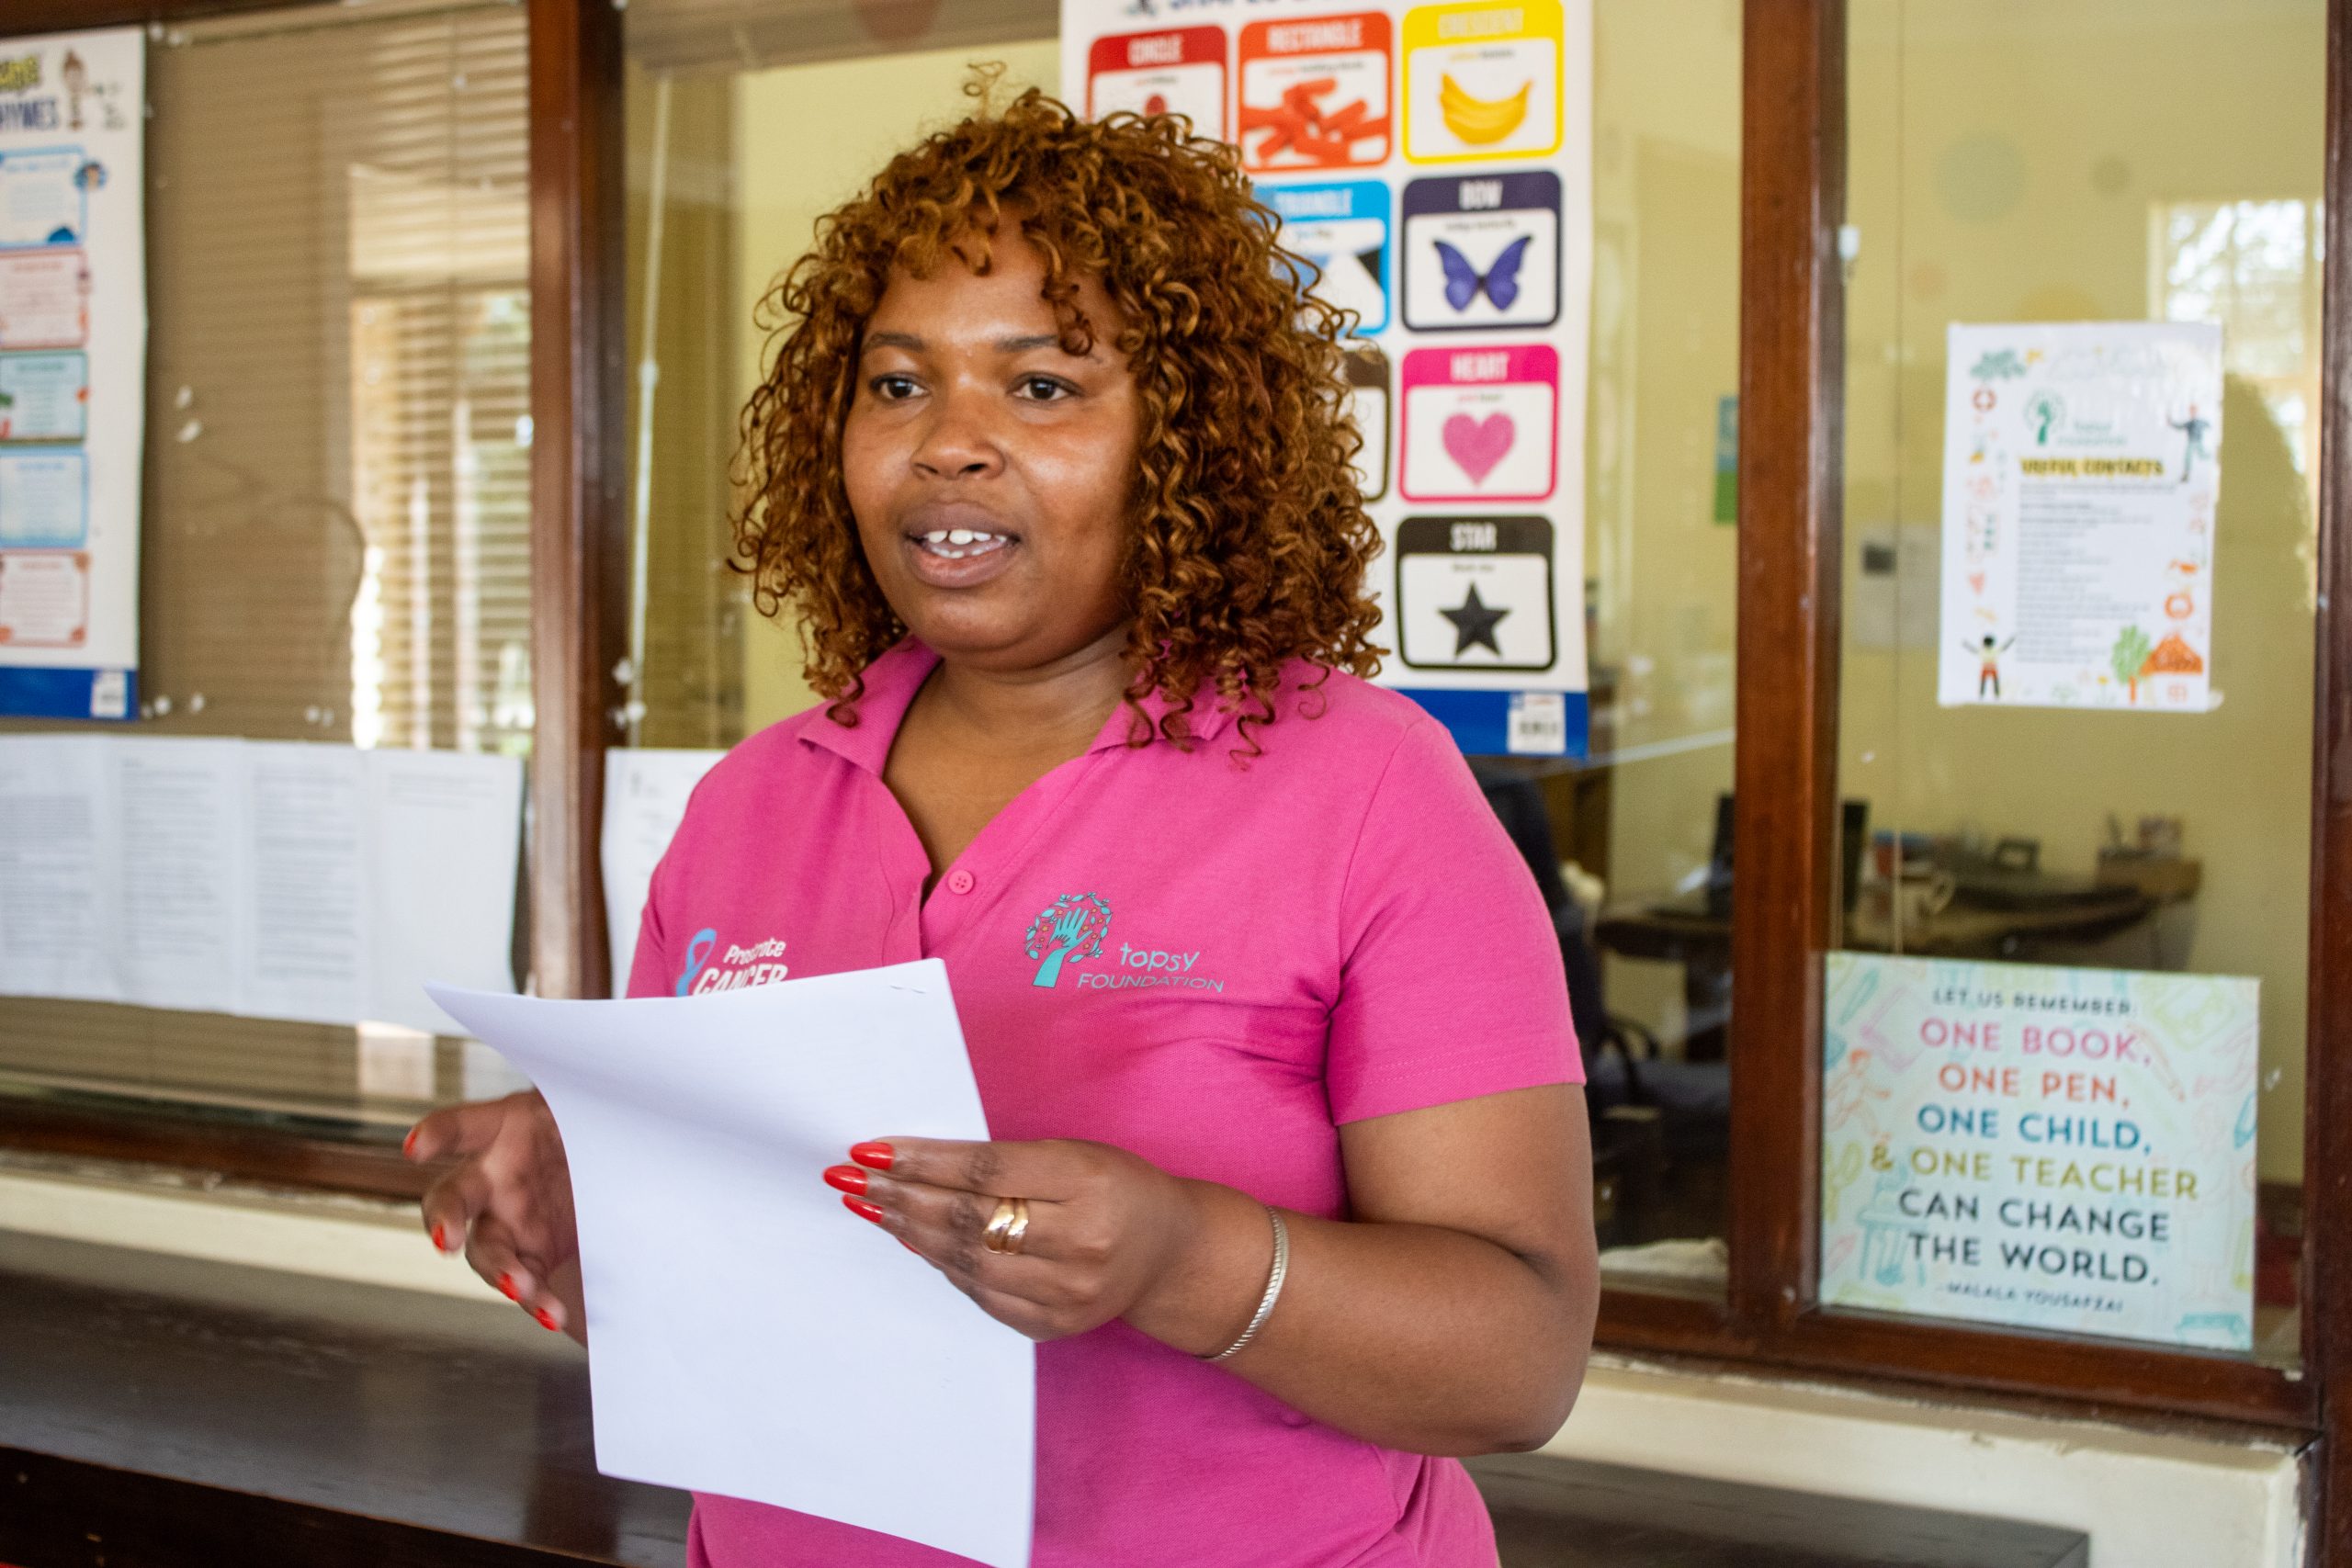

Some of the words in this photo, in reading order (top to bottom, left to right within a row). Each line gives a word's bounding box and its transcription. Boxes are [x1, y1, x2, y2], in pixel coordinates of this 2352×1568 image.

[1127, 33, 1183, 67] CIRCLE
[1267, 18, 1363, 52] RECTANGLE
[1458, 179, 1504, 210] BOW
[1450, 353, 1510, 381] HEART
[2021, 458, 2077, 476] USEFUL
[2084, 457, 2164, 476] CONTACTS
[1450, 522, 1497, 550] STAR
[1119, 942, 1201, 972] topsy
[1077, 973, 1225, 993] FOUNDATION
[1932, 987, 1968, 1006] LET
[1977, 991, 2005, 1008] US
[1919, 1016, 2001, 1052] ONE
[2023, 1023, 2152, 1066] BOOK,
[1939, 1061, 2020, 1097] ONE
[2042, 1068, 2130, 1111] PEN,
[1917, 1103, 1999, 1138] ONE
[2018, 1113, 2152, 1156] CHILD,
[1871, 1143, 1894, 1172] &
[1911, 1146, 1992, 1181] ONE
[2010, 1154, 2199, 1200] TEACHER
[1898, 1189, 1979, 1223] CAN
[1999, 1198, 2170, 1243] CHANGE
[1907, 1231, 1981, 1266] THE
[1999, 1240, 2159, 1286] WORLD.
[2024, 1289, 2124, 1313] YOUSAFZAI
